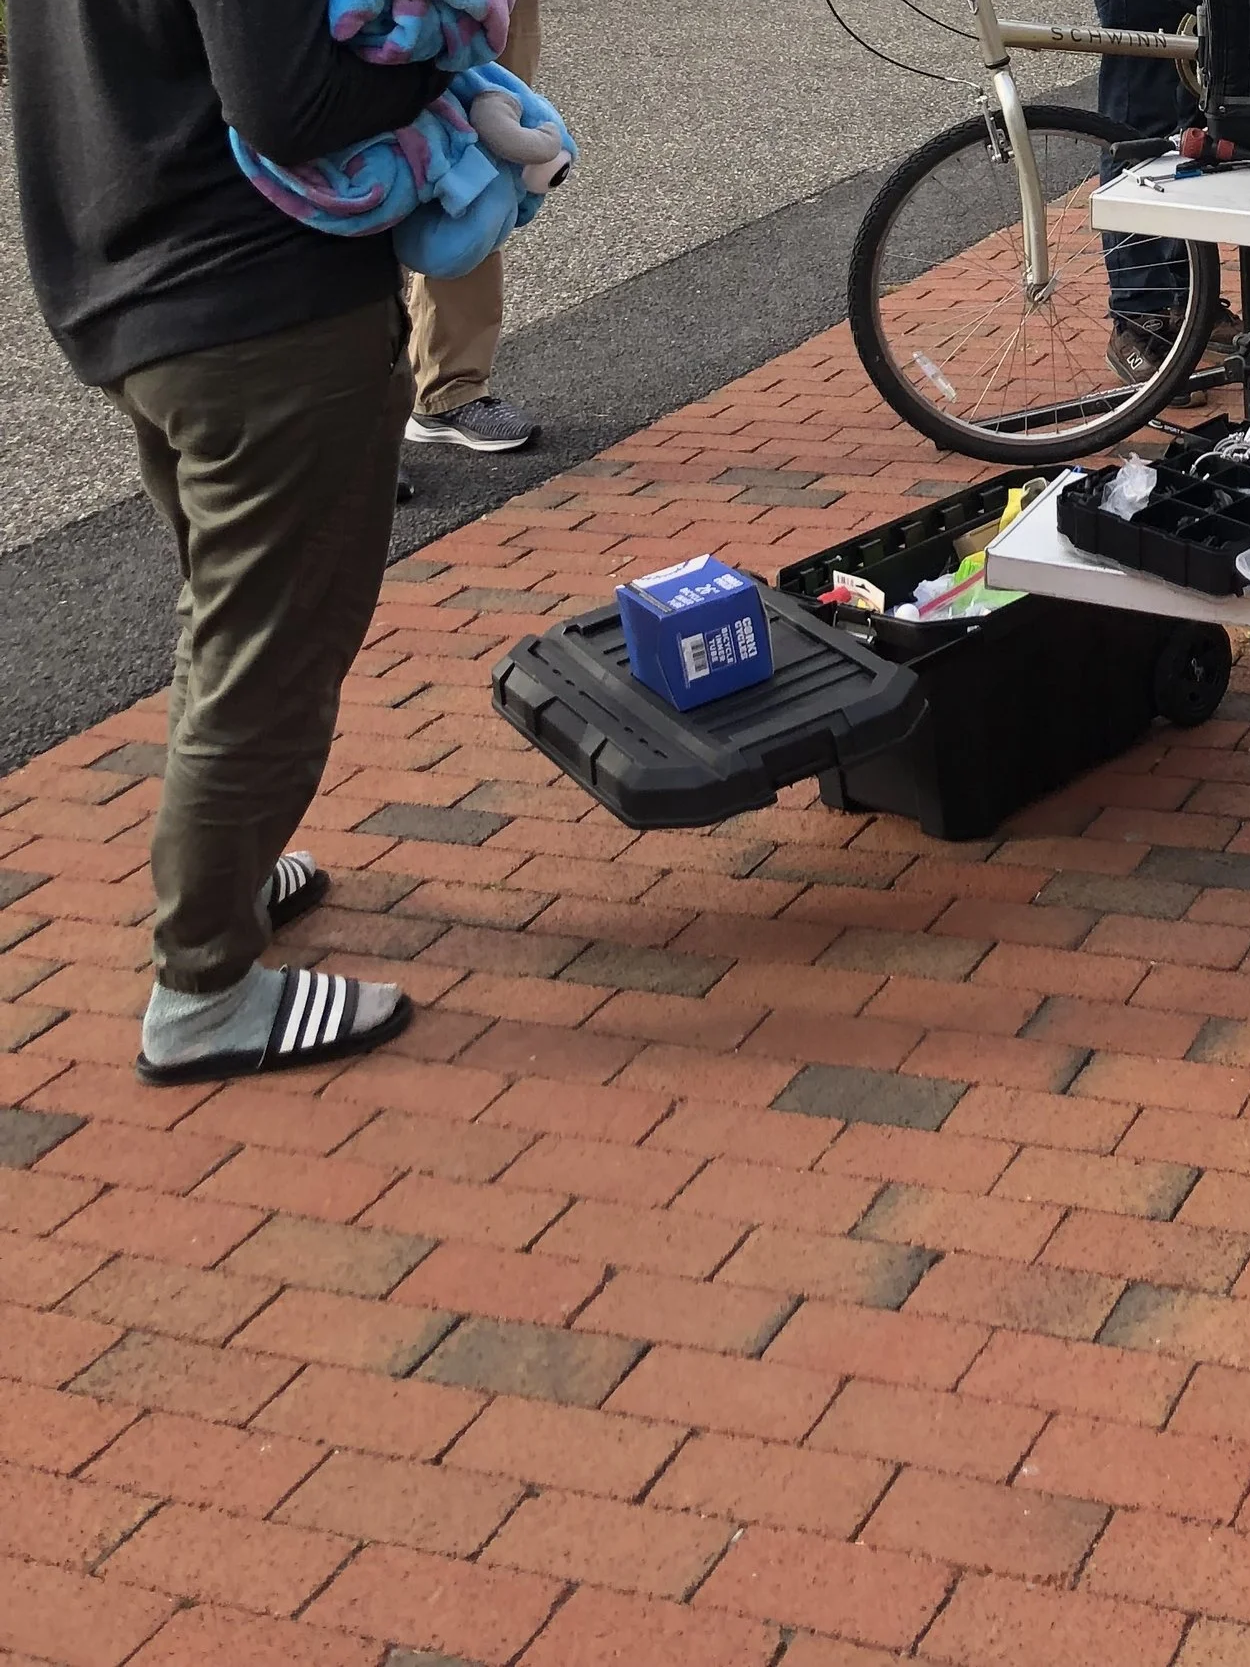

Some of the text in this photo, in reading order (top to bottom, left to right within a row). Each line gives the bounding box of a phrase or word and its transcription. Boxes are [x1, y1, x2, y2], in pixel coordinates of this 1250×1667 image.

[1051, 26, 1168, 49] SCHWINN
[1126, 352, 1144, 370] N
[709, 638, 719, 663] TUBE
[715, 634, 726, 662] INNER
[721, 626, 733, 664] BICYCLE
[734, 620, 748, 660] CYCLES
